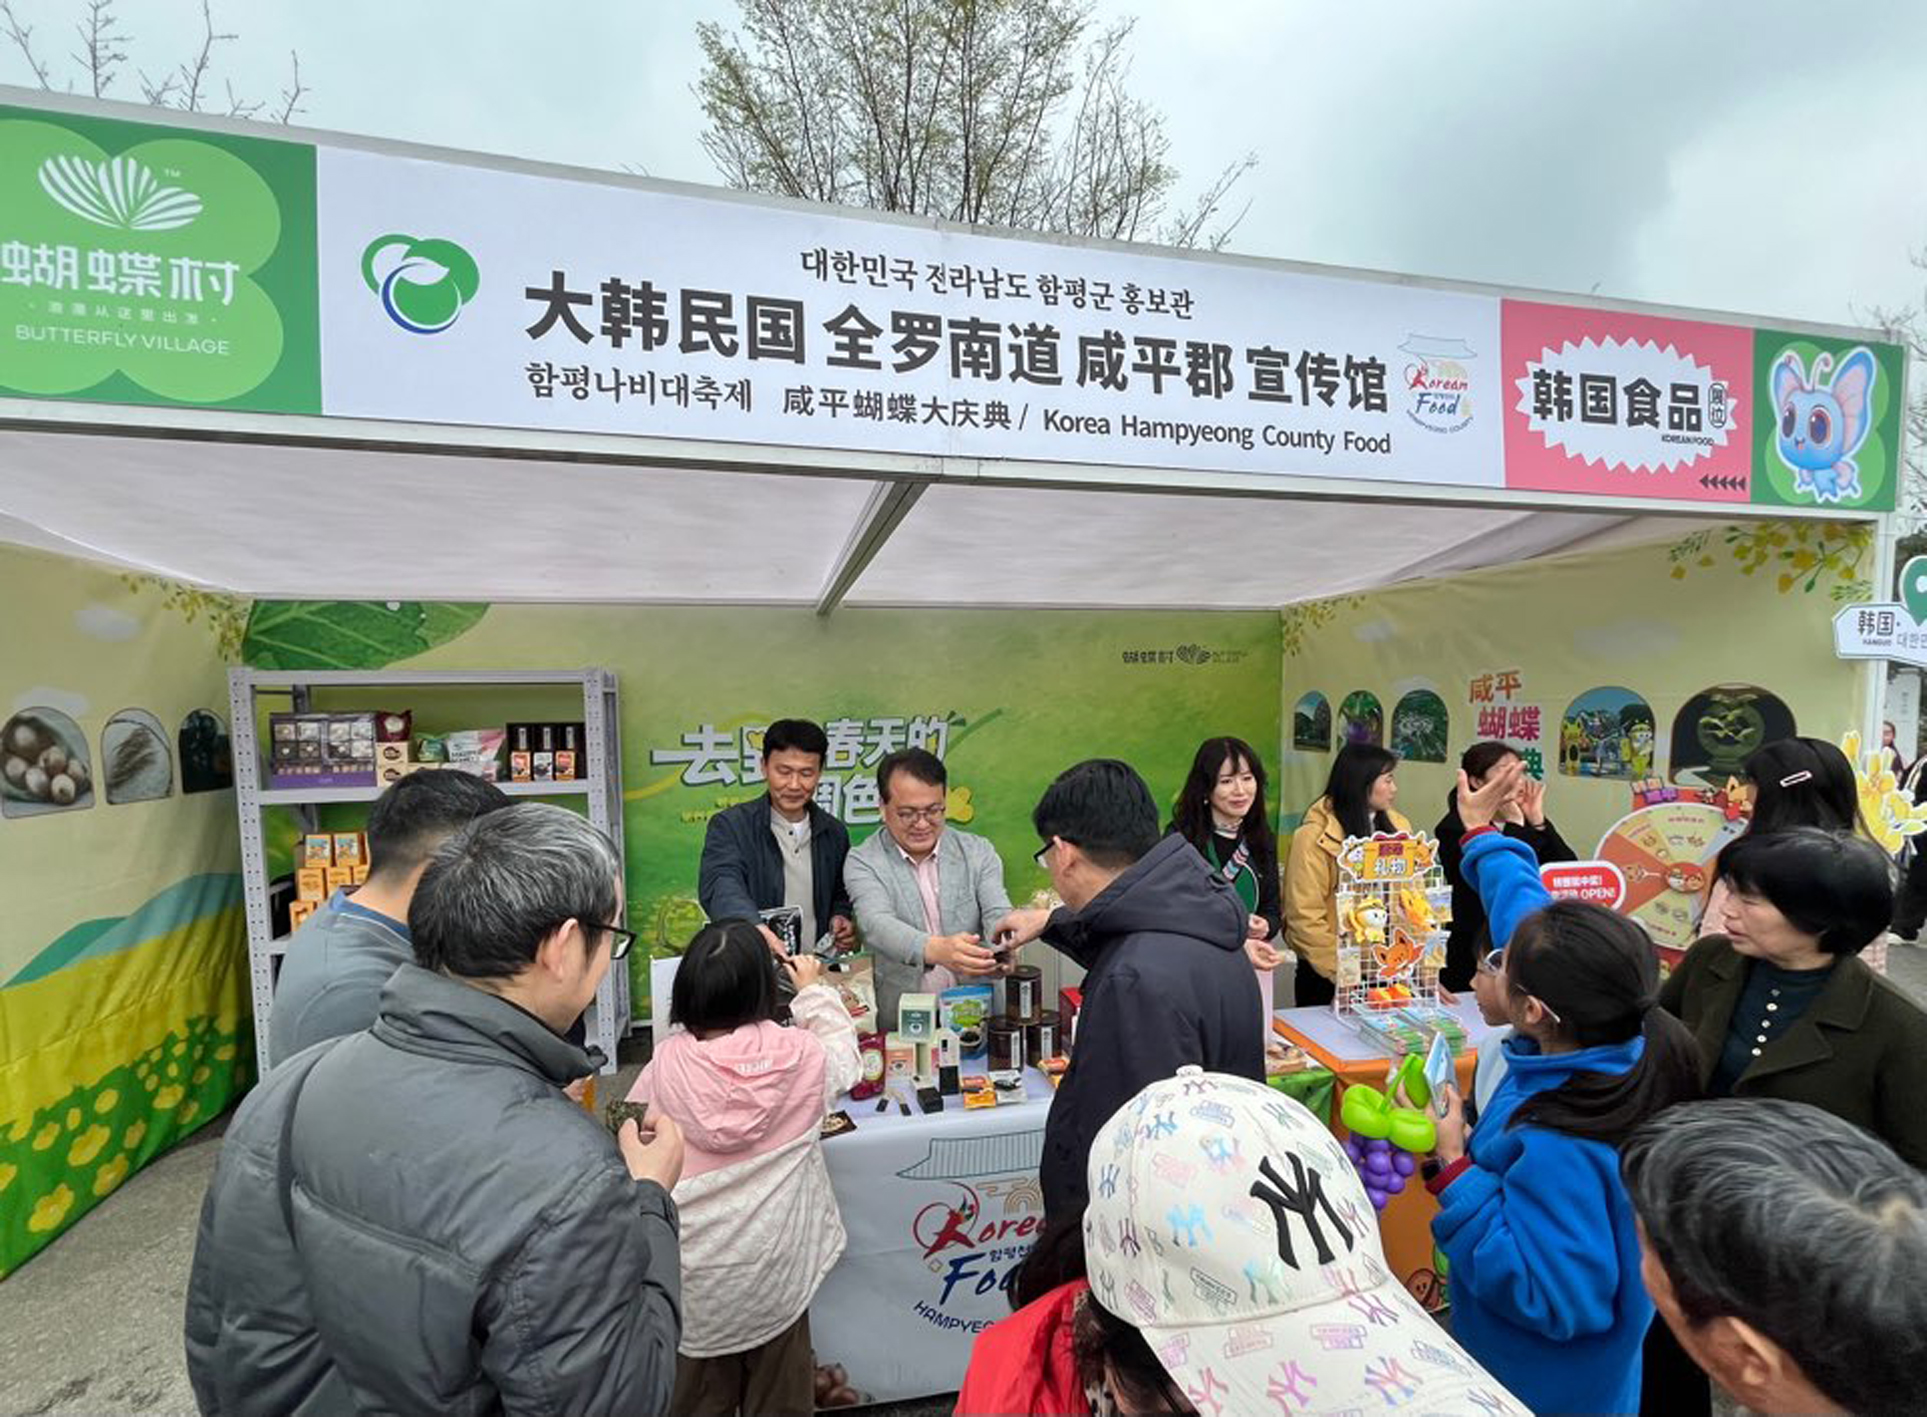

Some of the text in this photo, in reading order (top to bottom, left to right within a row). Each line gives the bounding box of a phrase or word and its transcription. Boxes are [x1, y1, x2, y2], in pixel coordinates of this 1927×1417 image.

[0, 240, 240, 307] 蝴蝶村
[800, 247, 1195, 320] 대한민국 전라남도 함평군 홍보관
[15, 324, 230, 356] BUTTERFLY VILLAGE
[525, 270, 1389, 413] 大韩民国 全罗南道 咸平郡 宣传馆
[525, 361, 752, 412] 함평나비대축제
[1404, 364, 1468, 390] Korean
[1532, 369, 1702, 433] 韩国食品
[783, 384, 1012, 430] 咸平蝴蝶大庆典
[1043, 408, 1110, 436] Korea
[1121, 419, 1255, 449] Hampyeong
[1263, 429, 1336, 454] County
[1343, 432, 1391, 454] Food
[1415, 392, 1460, 415] Food
[1858, 610, 1895, 636] 韩国
[1469, 670, 1522, 704] 咸平
[1478, 706, 1541, 741] 蝴蝶
[1250, 1150, 1354, 1271] NY
